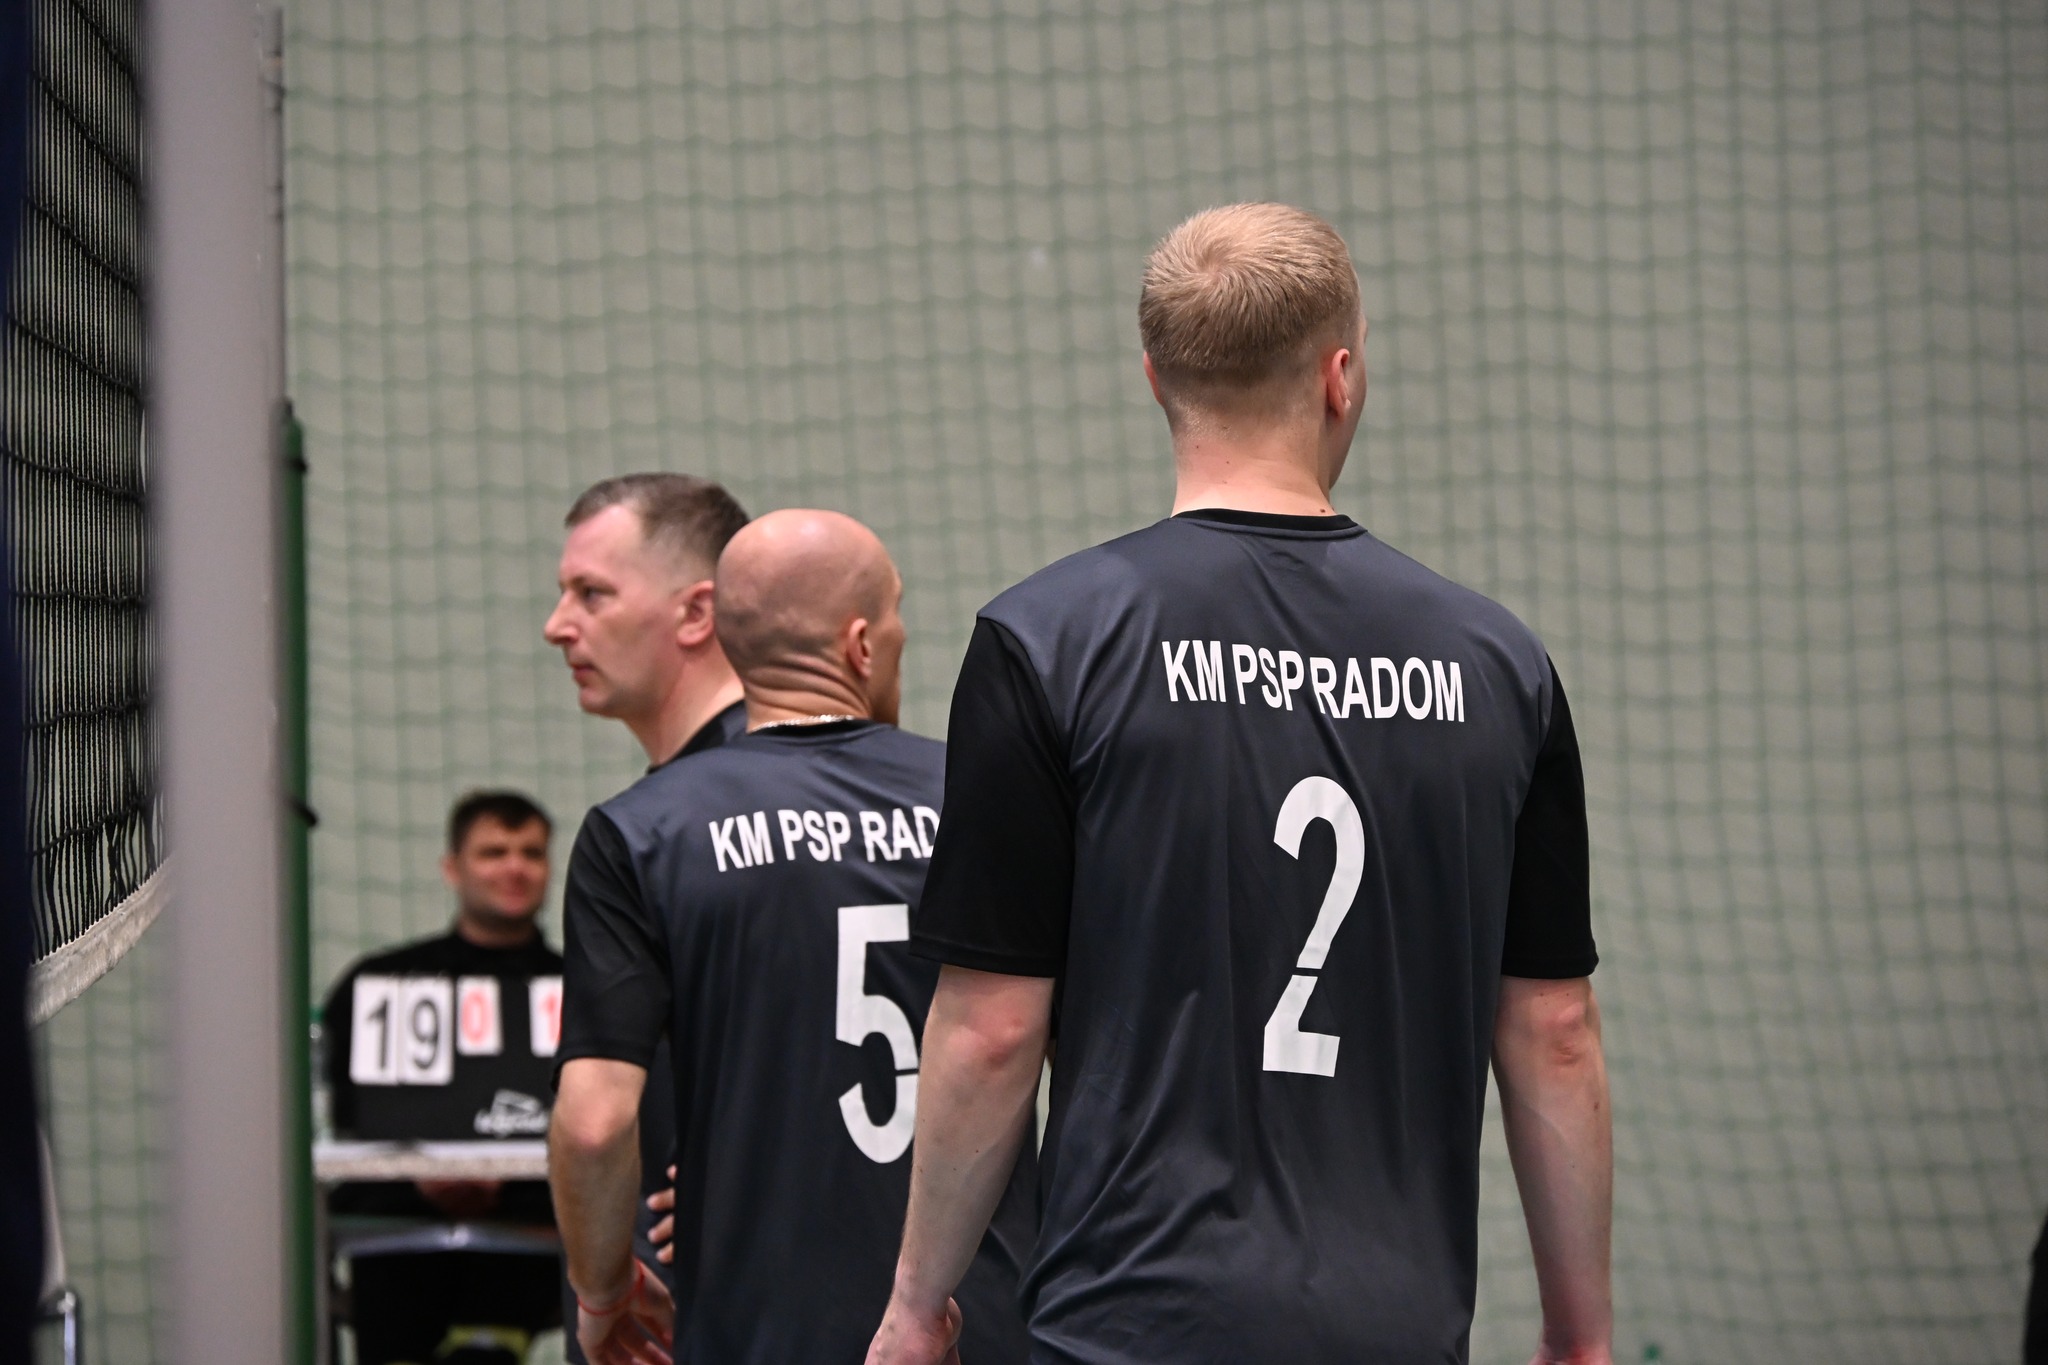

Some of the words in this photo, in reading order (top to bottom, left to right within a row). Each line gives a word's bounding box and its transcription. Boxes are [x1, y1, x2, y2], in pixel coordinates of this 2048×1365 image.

[1161, 639, 1227, 703] KM
[1232, 643, 1305, 711] PSP
[1309, 656, 1465, 723] RADOM
[708, 811, 774, 872] KM
[777, 809, 851, 862] PSP
[1262, 775, 1366, 1078] 2
[366, 995, 441, 1071] 19
[460, 989, 493, 1046] 0
[835, 903, 919, 1164] 5
